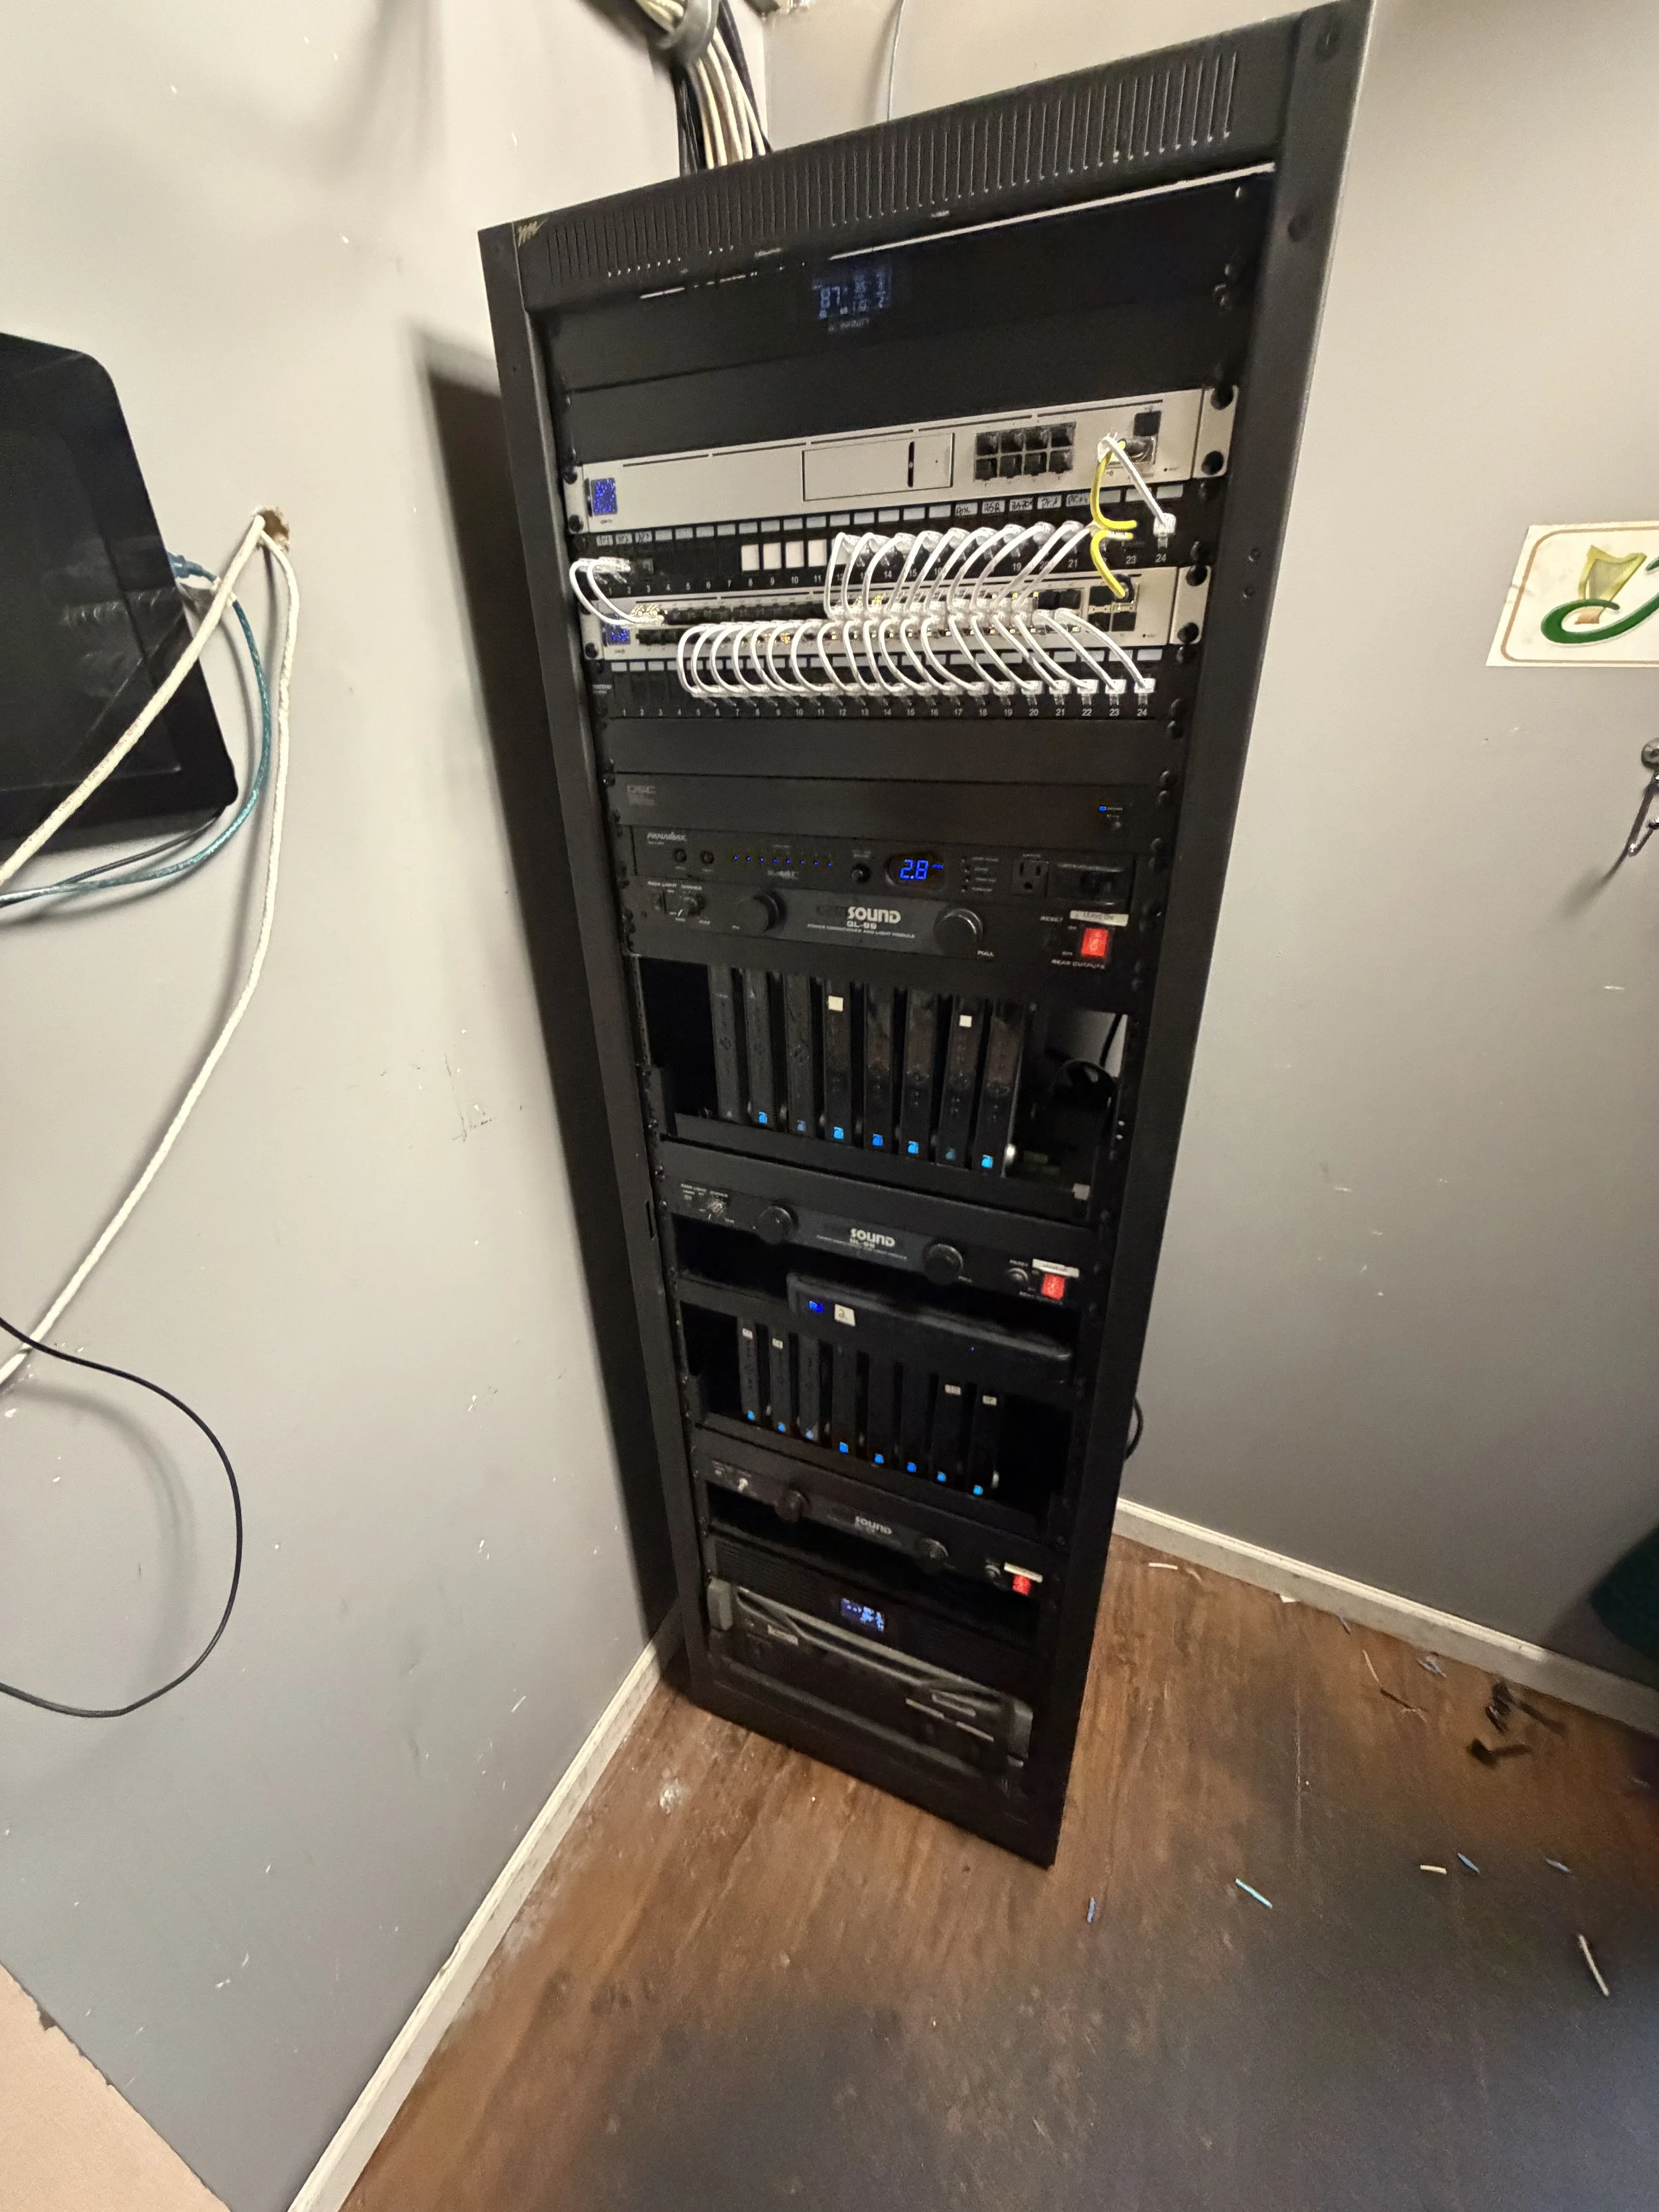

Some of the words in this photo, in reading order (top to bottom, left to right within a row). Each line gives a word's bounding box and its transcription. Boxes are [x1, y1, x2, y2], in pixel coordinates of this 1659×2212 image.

[791, 576, 799, 585] 10
[814, 574, 822, 583] 11
[883, 570, 893, 579] 14
[909, 569, 917, 577] 15
[1012, 562, 1022, 571] 19
[1068, 559, 1078, 568] 21
[1125, 555, 1137, 564] 23
[1155, 553, 1167, 563] 24
[839, 708, 847, 717] 12
[861, 708, 869, 717] 13
[907, 708, 915, 717] 15
[979, 708, 987, 717] 18
[1003, 708, 1013, 717] 19
[1029, 708, 1039, 717] 20
[1055, 708, 1065, 717] 21
[1082, 708, 1092, 717] 22
[1109, 708, 1120, 717] 23
[1137, 708, 1148, 717] 24
[900, 859, 929, 881] 2.8
